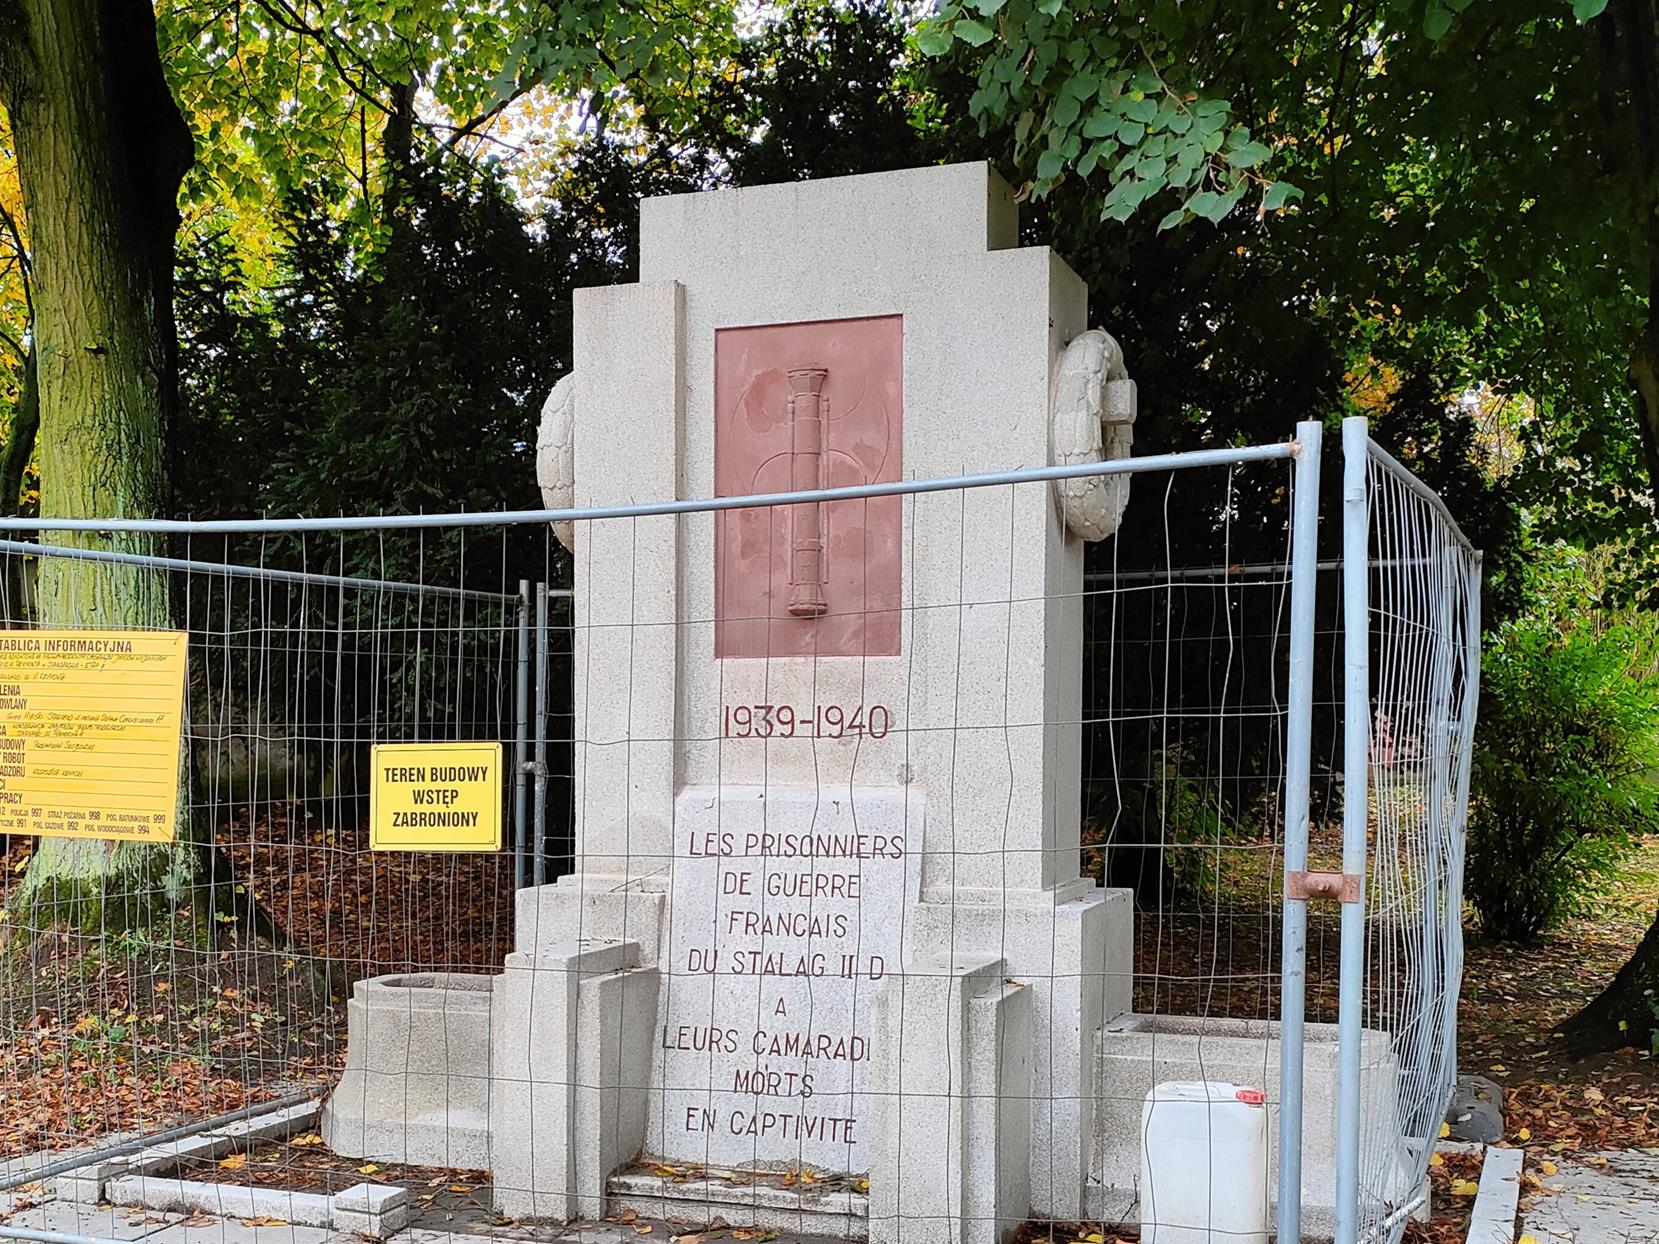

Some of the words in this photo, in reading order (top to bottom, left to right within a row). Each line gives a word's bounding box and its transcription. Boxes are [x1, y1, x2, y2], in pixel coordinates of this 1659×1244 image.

[0, 639, 40, 651] TABLICA
[44, 640, 132, 653] INFORMACYJNA
[725, 705, 889, 739] 1939-1940
[3, 752, 26, 764] ROBOT
[384, 767, 426, 782] TEREN
[430, 767, 488, 782] BUDOWY
[413, 789, 459, 808] WSTĘP
[11, 809, 29, 817] POLICJA
[31, 808, 42, 818] 997
[89, 811, 101, 821] 998
[153, 814, 166, 824] 999
[392, 812, 479, 828] ZABRONIONY
[17, 818, 27, 829] 991
[67, 821, 79, 831] 992
[137, 825, 150, 835] 994
[689, 831, 735, 857] LES
[744, 833, 904, 860] PRISONNIERS
[723, 871, 752, 896] DE
[767, 873, 861, 899] GUERRE
[688, 949, 718, 974] DU
[731, 951, 825, 978] STALAG
[841, 954, 854, 979] II
[869, 956, 885, 981] D
[774, 997, 787, 1017] A
[662, 1025, 739, 1053] LEURS
[733, 1069, 815, 1098] MORTS
[686, 1107, 716, 1132] EN
[730, 1111, 857, 1144] CAPTIVITE
